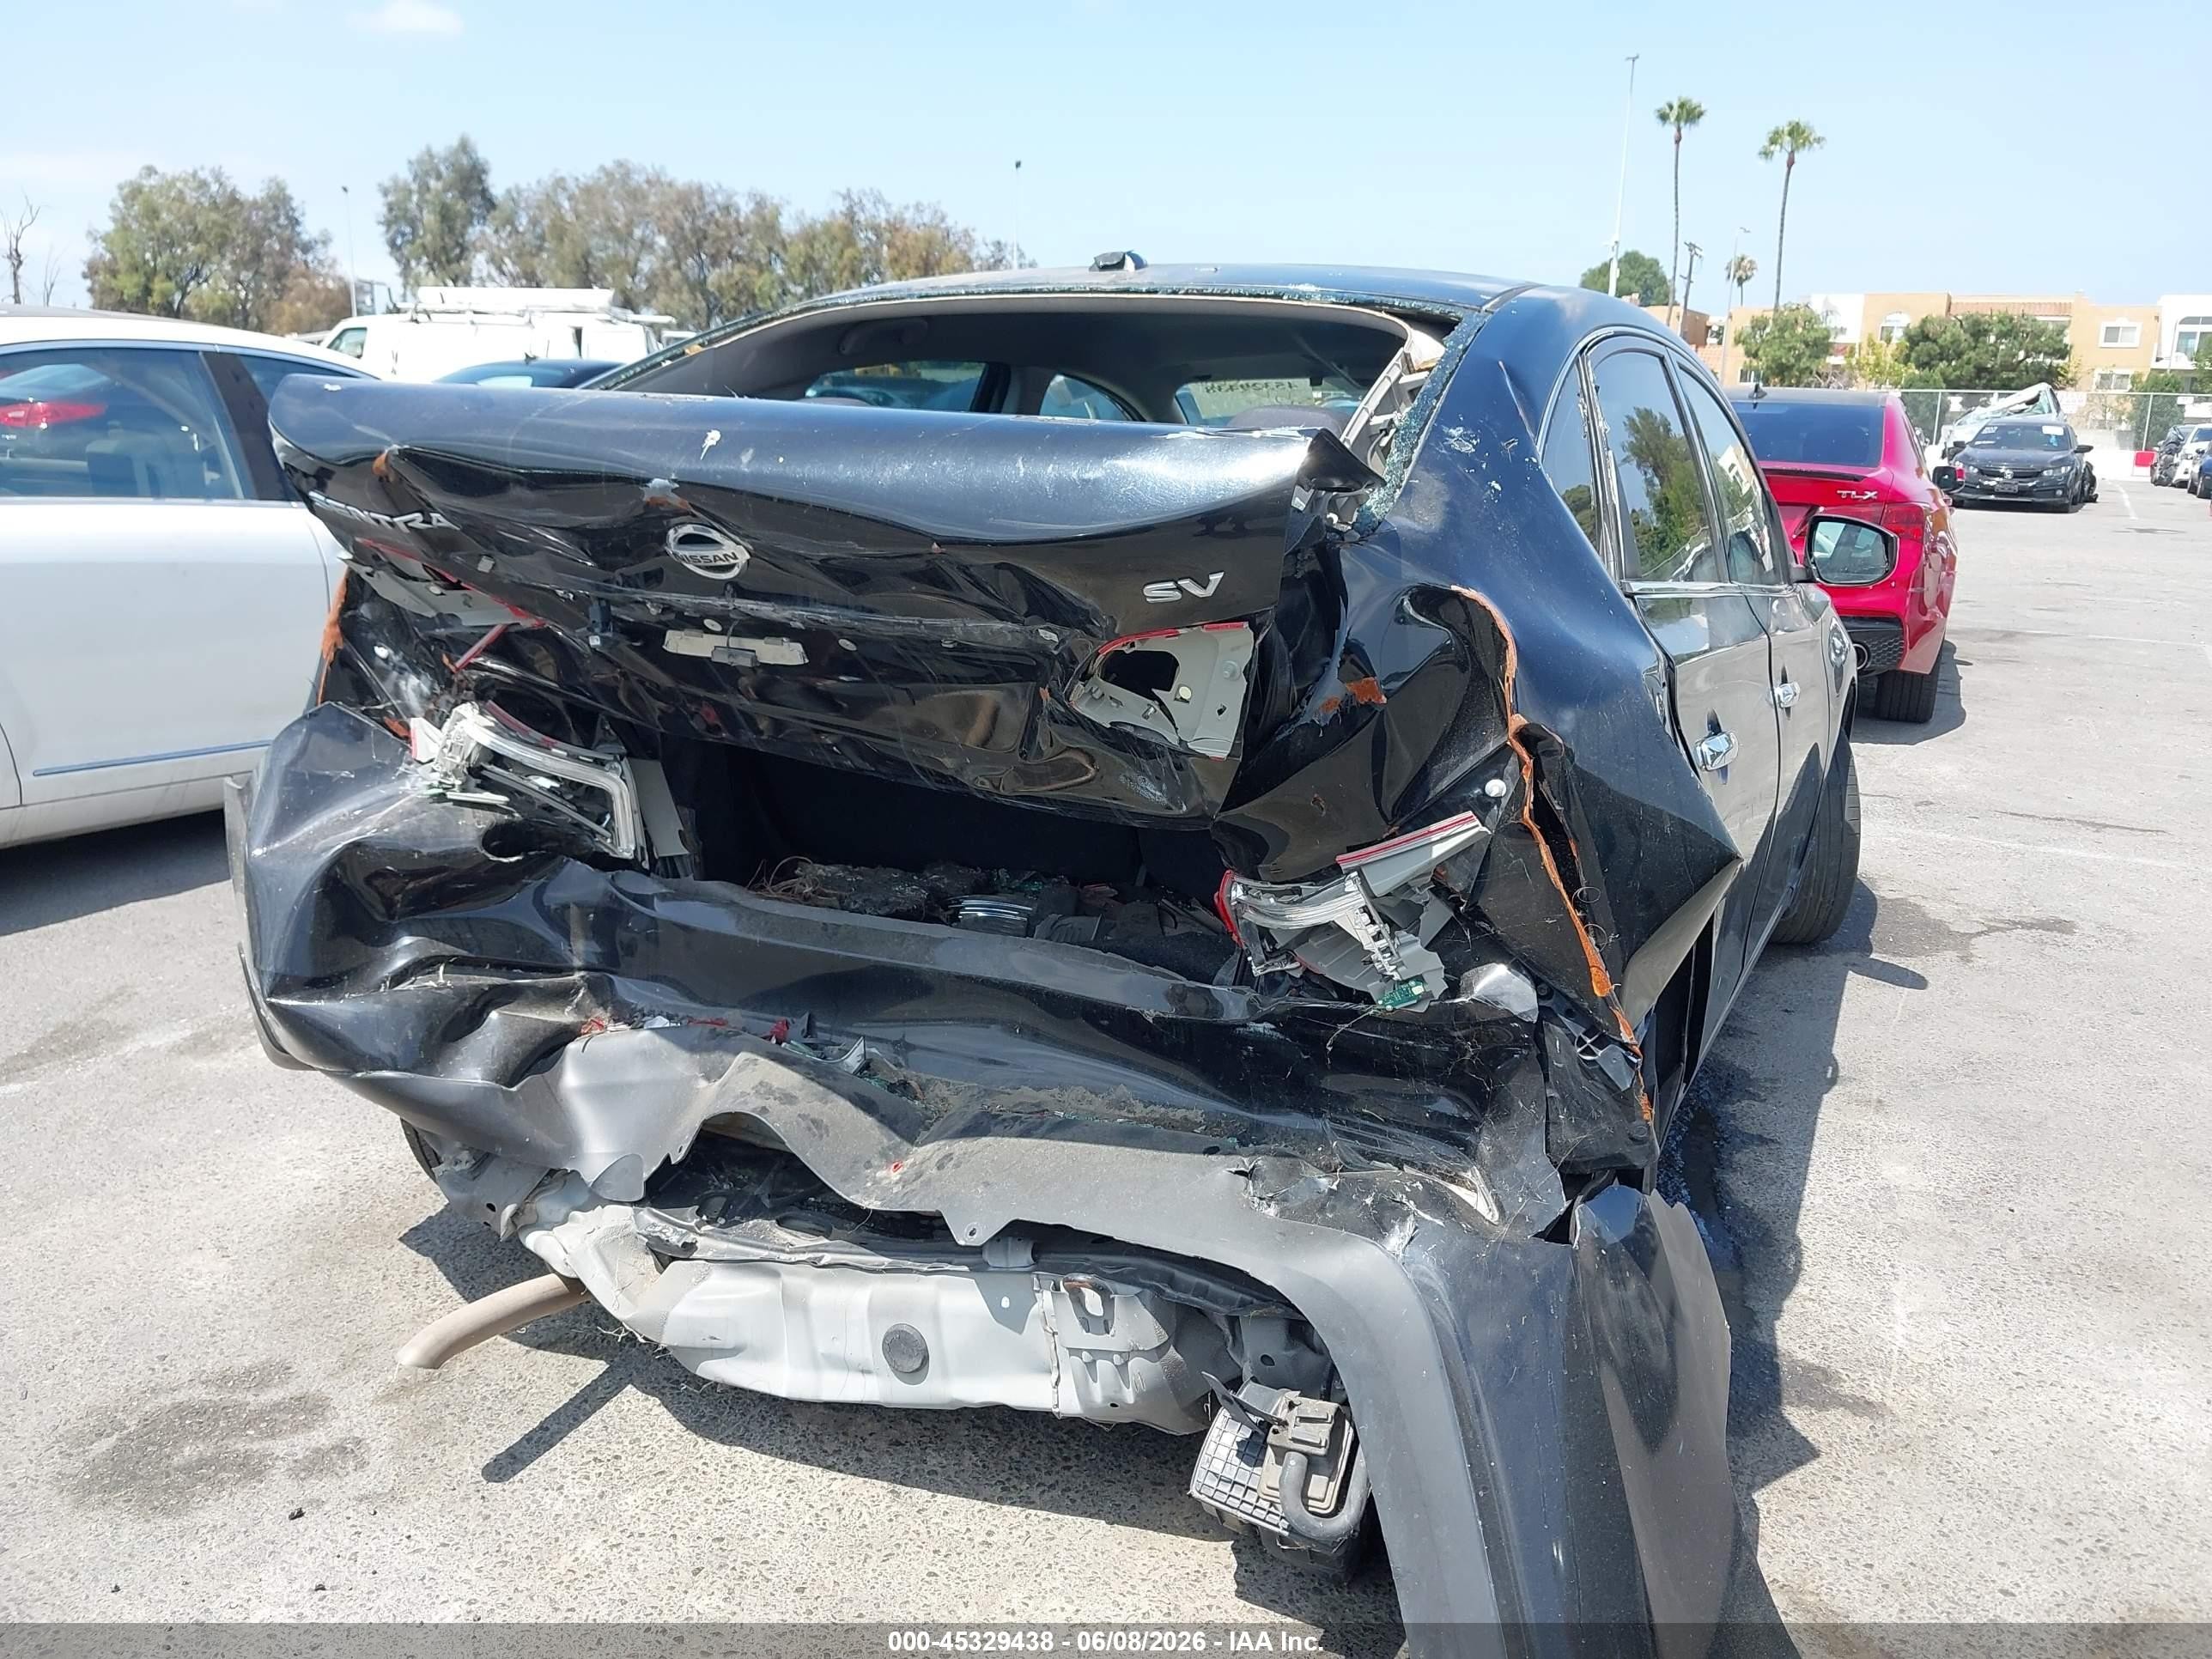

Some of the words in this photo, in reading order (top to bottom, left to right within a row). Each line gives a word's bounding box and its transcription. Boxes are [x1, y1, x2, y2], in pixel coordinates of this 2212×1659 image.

[1837, 490, 1878, 500] TLX
[674, 551, 740, 564] NISSAN
[1143, 571, 1225, 603] SV
